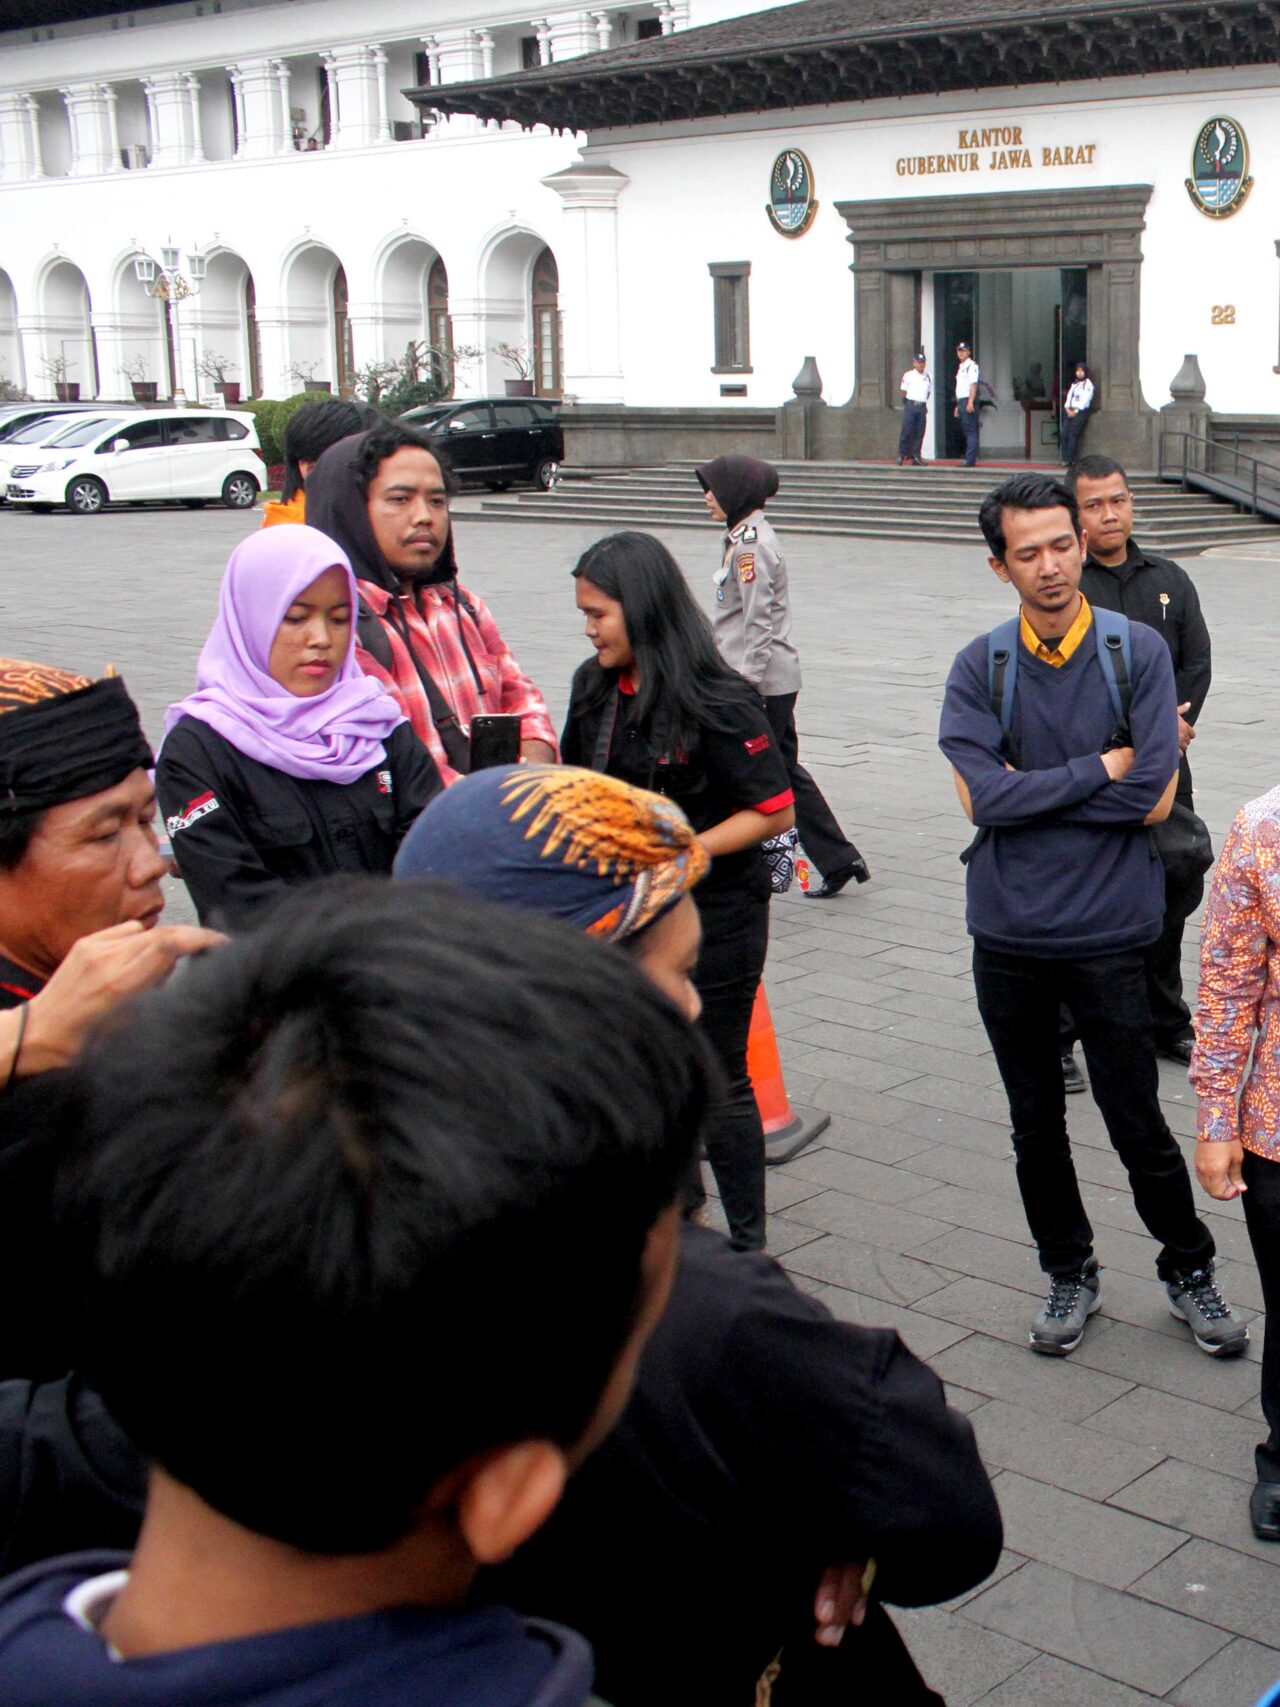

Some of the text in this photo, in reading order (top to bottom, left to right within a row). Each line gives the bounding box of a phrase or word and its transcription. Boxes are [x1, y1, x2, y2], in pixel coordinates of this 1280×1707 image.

[958, 126, 1023, 149] KANTOR
[896, 144, 1097, 176] GUBERNUR JAWA BARAT
[1211, 304, 1236, 325] 22
